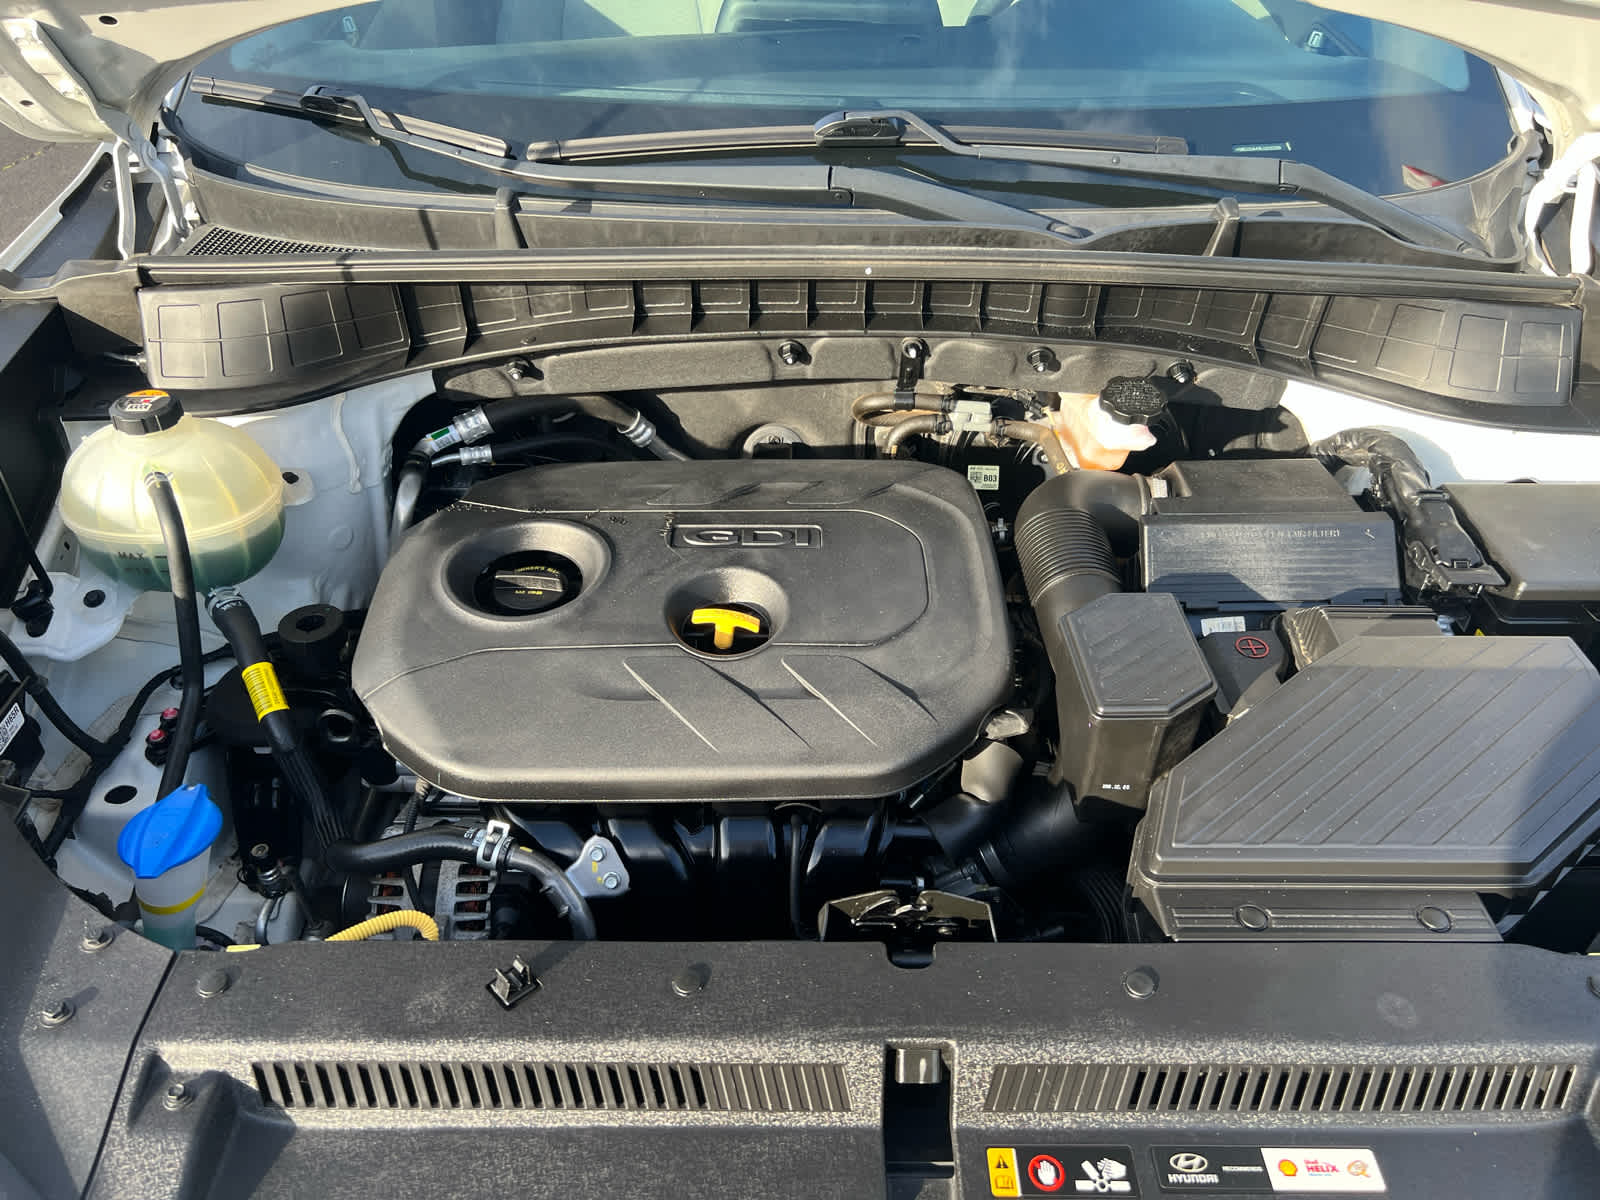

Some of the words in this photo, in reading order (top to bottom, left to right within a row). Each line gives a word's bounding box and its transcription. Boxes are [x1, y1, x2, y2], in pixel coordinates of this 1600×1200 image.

[682, 529, 814, 547] GDI
[117, 551, 145, 561] MAX
[1306, 1165, 1340, 1173] HELIX
[1167, 1173, 1220, 1184] HYUNDAI
